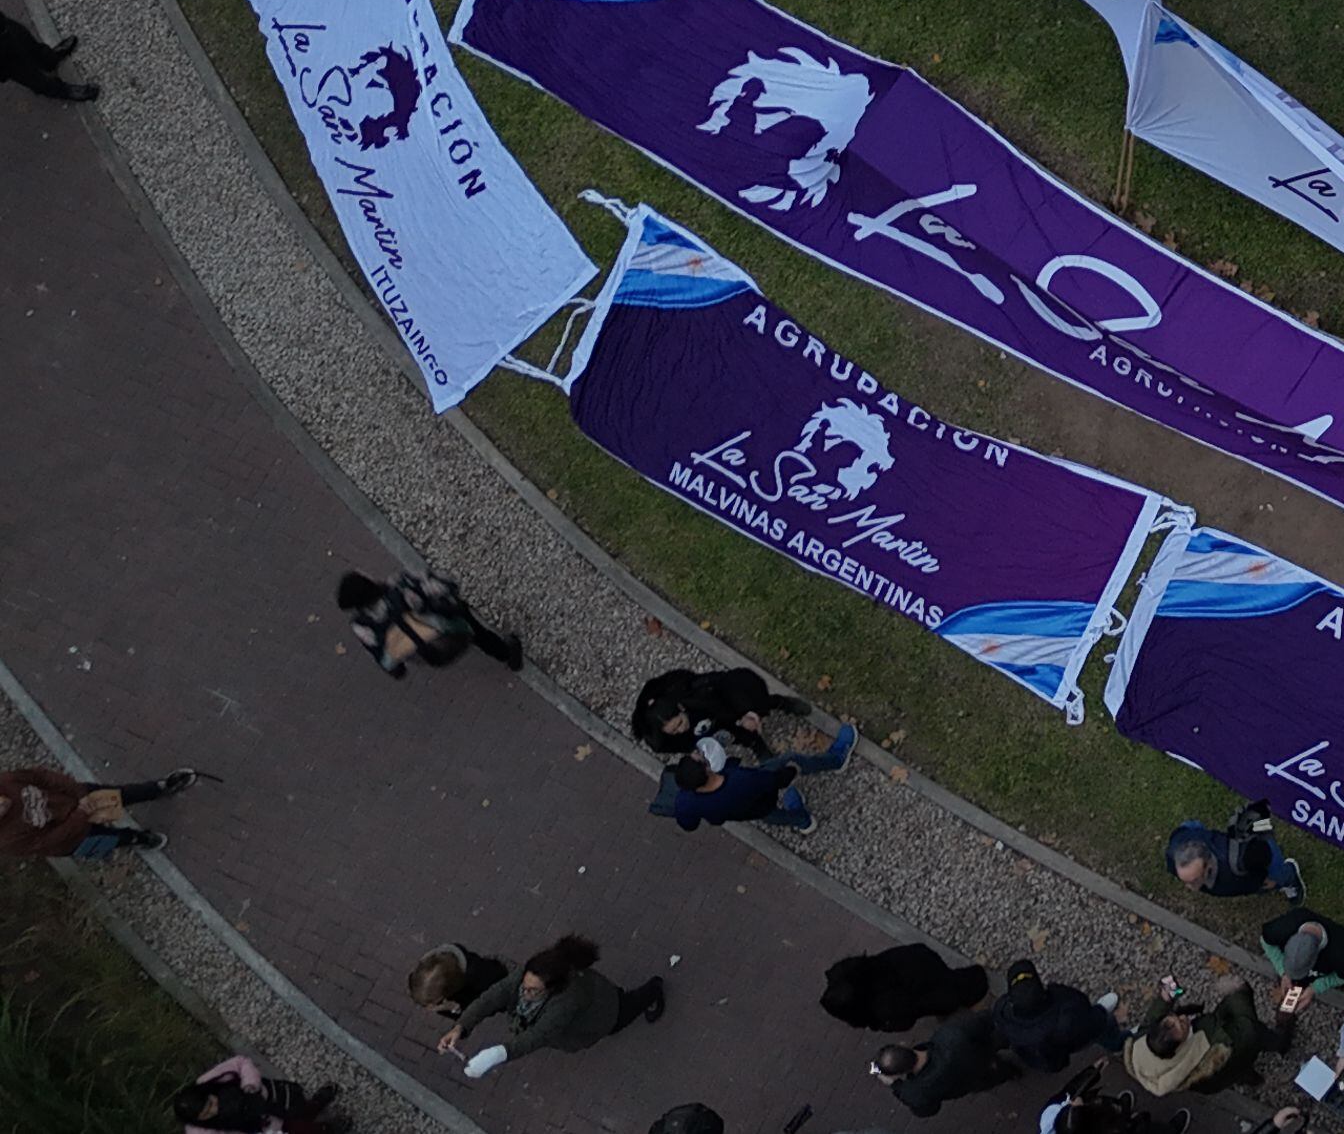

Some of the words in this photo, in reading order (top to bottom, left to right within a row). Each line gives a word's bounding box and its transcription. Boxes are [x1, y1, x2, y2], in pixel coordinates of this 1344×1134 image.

[271, 16, 328, 78] La
[333, 156, 404, 270] Martin
[1267, 167, 1340, 224] La
[667, 460, 787, 543] MALVINAS
[786, 529, 946, 630] ARGENTINAS
[689, 429, 754, 492] La
[827, 505, 943, 576] Martin
[1263, 739, 1332, 802] La
